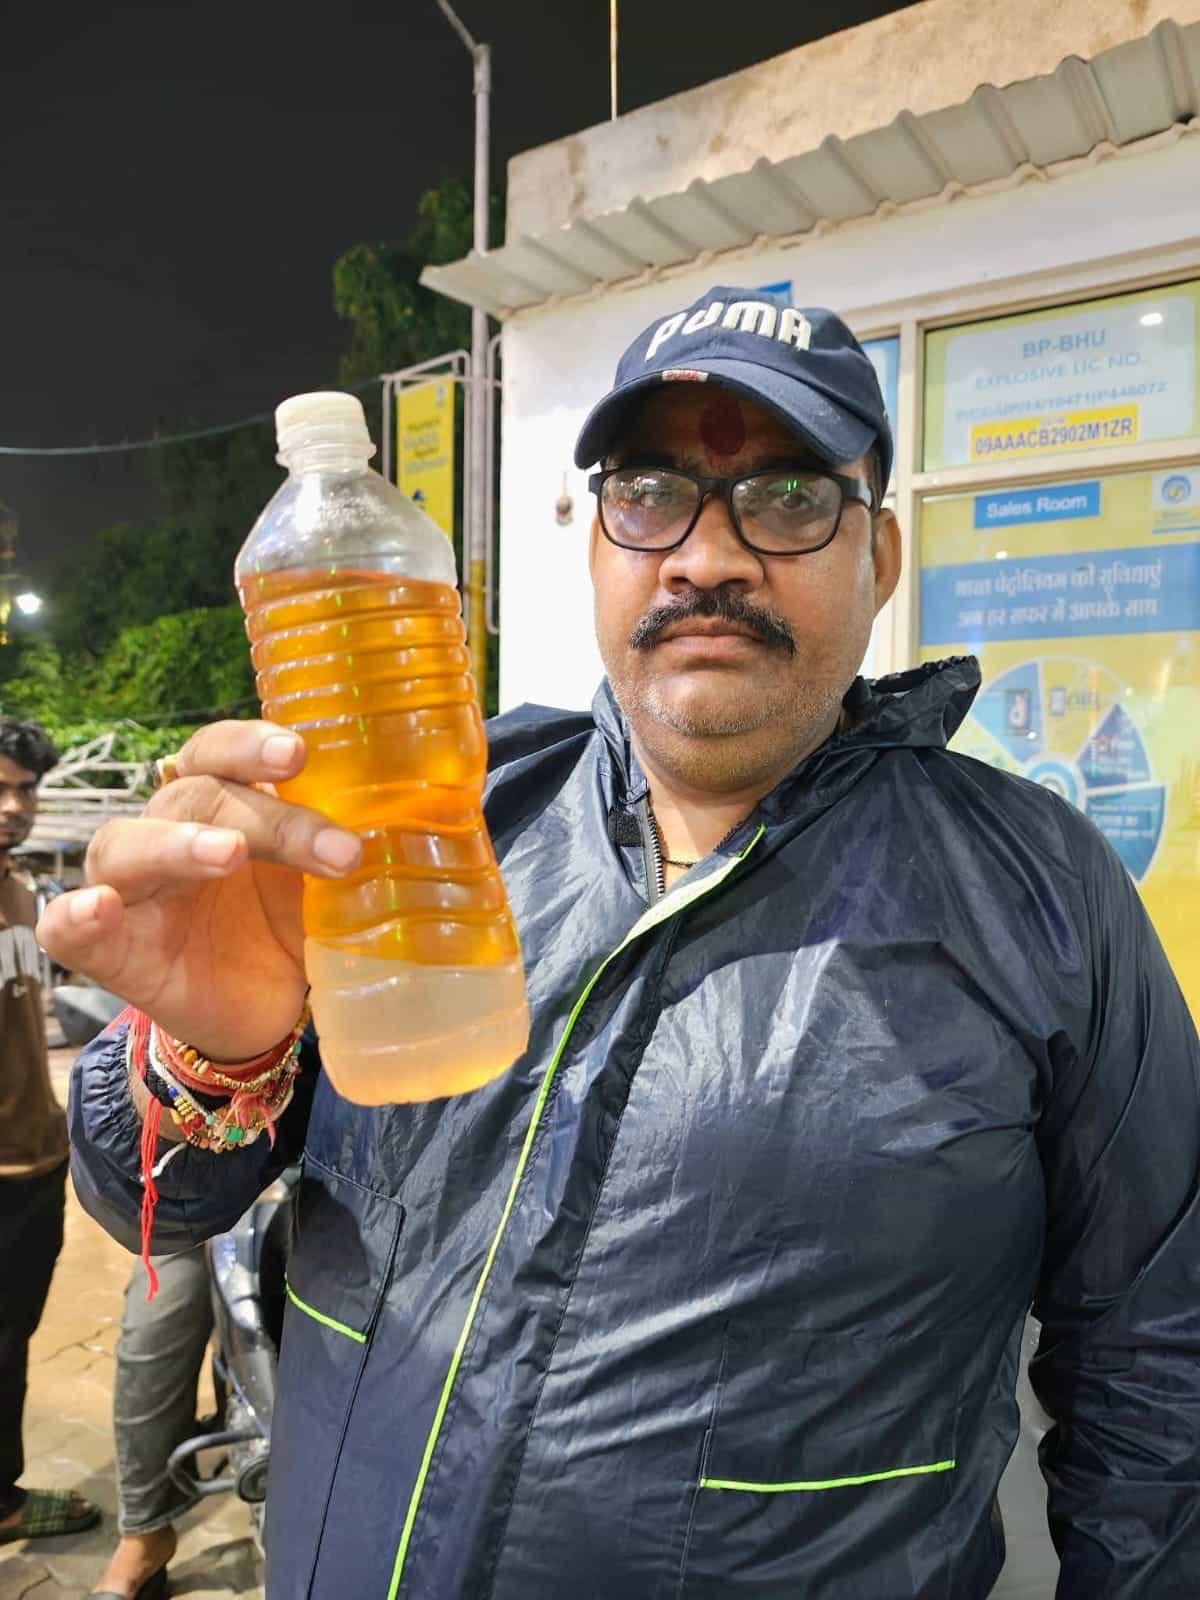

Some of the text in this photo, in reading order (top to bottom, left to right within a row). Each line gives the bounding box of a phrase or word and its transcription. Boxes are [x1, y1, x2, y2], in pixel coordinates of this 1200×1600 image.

[644, 300, 811, 361] PUMA
[1023, 329, 1106, 359] BP-BHU
[975, 363, 1066, 390] EXPLOSIVE
[975, 417, 1132, 455] 09AAACB2902M1ZR
[986, 494, 1087, 519] Sales Room
